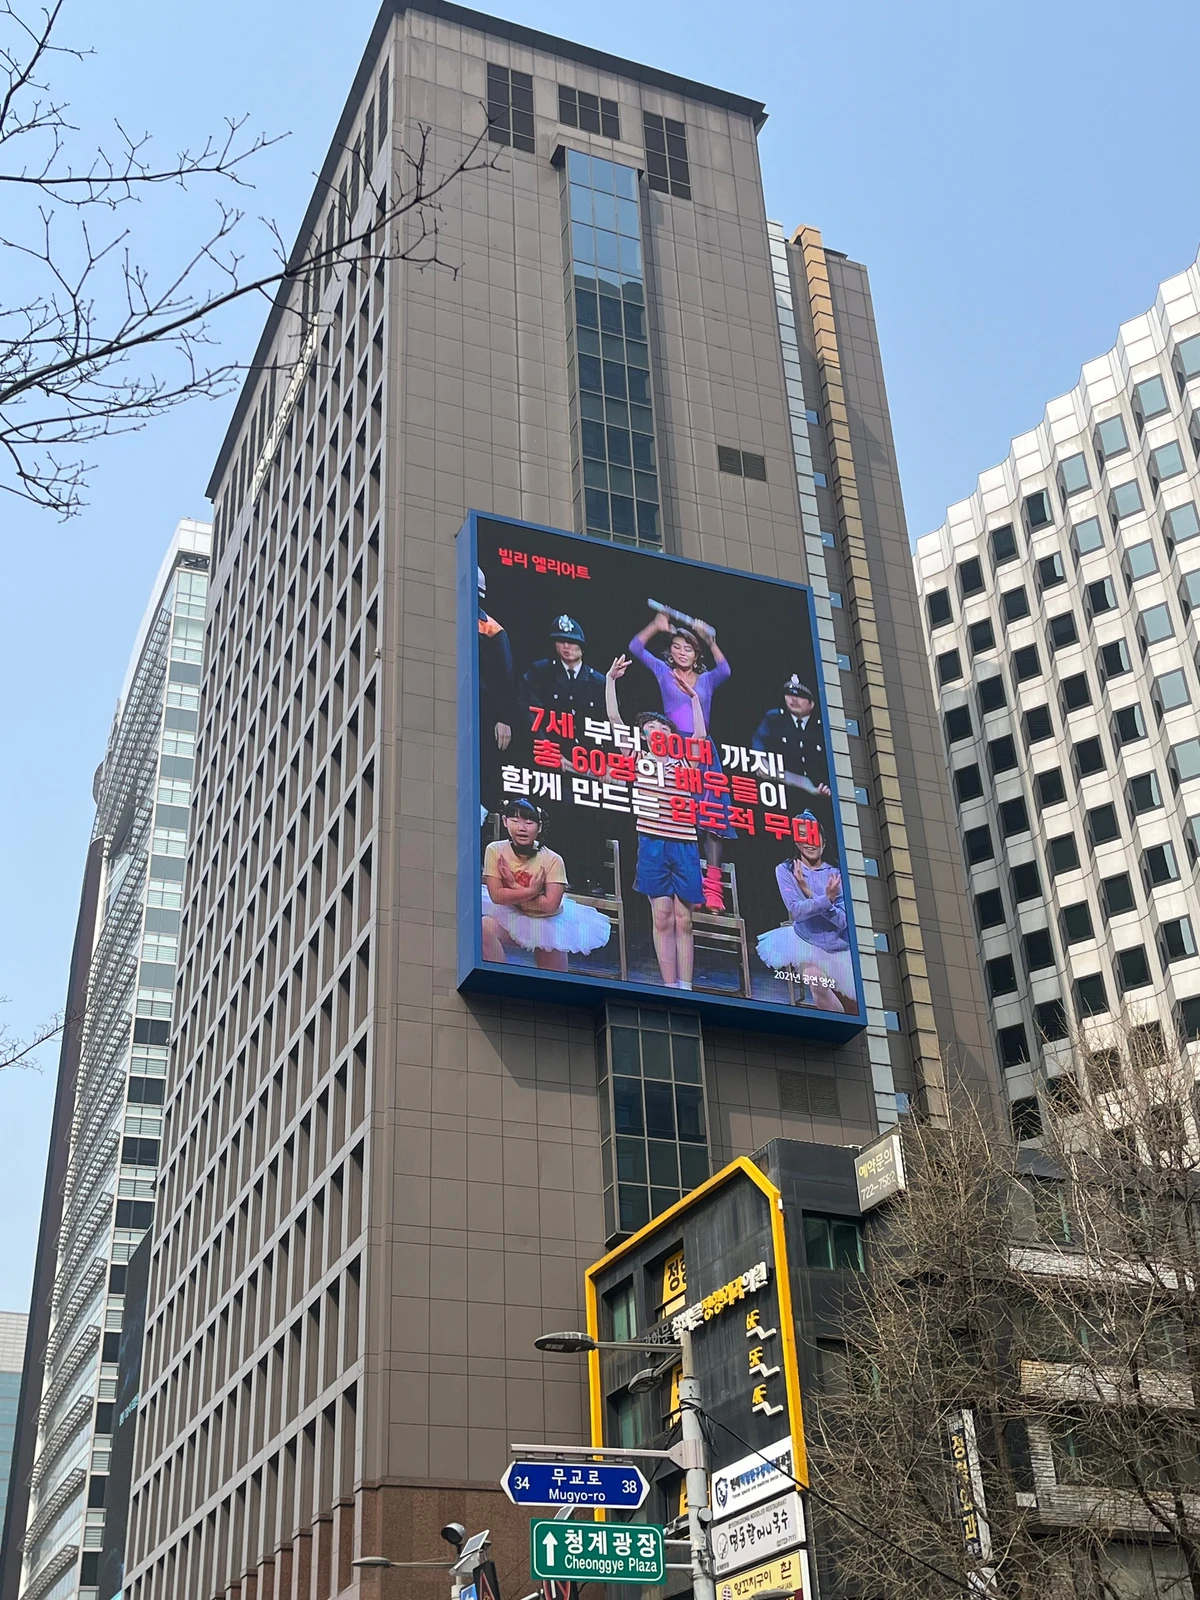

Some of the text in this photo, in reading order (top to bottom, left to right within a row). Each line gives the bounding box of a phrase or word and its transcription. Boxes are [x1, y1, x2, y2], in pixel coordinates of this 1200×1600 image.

[498, 547, 591, 579] 빌리 엘리어트
[529, 706, 785, 778] 7세 부터 80대 까지!
[533, 739, 788, 810] 총 60명의 배우들이
[501, 764, 820, 847] 함께 만드는 압도적 무대
[773, 970, 836, 989] 2021년 공연 영상
[858, 1147, 893, 1179] 예약문의
[514, 1477, 530, 1490] 34
[551, 1468, 602, 1486] 무교로
[621, 1480, 638, 1494] 38
[549, 1488, 606, 1503] Mugyo-ro
[564, 1529, 656, 1557] 청계광장
[729, 1509, 788, 1552] 명동할머니국수
[564, 1554, 658, 1574] Cheonggye Plaza
[734, 1560, 792, 1595] 양꼬치구이 찬
